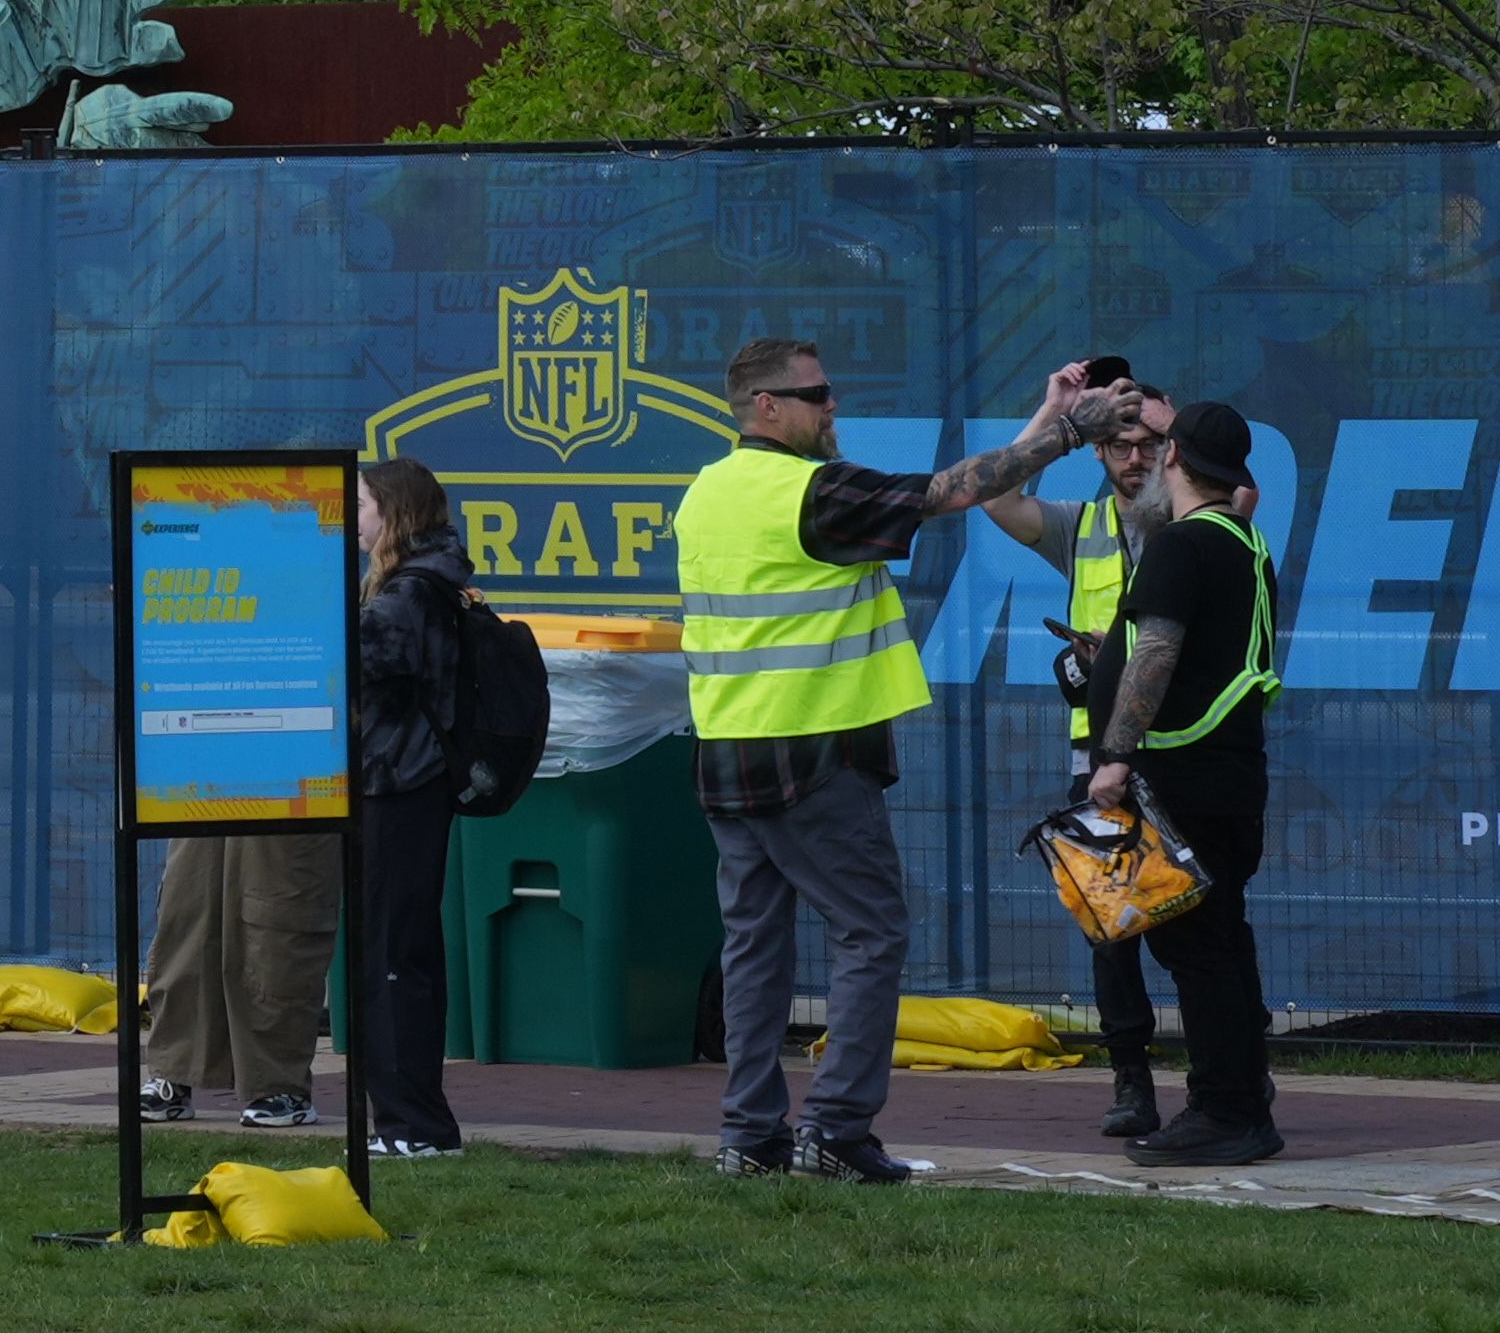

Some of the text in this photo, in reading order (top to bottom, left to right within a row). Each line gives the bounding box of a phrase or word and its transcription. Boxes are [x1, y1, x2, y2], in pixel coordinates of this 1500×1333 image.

[517, 355, 612, 434] NFL
[153, 523, 200, 534] EXPERIENCE
[460, 500, 664, 578] RAF
[142, 567, 241, 596] CHILD ID
[142, 596, 258, 624] PROGRAM
